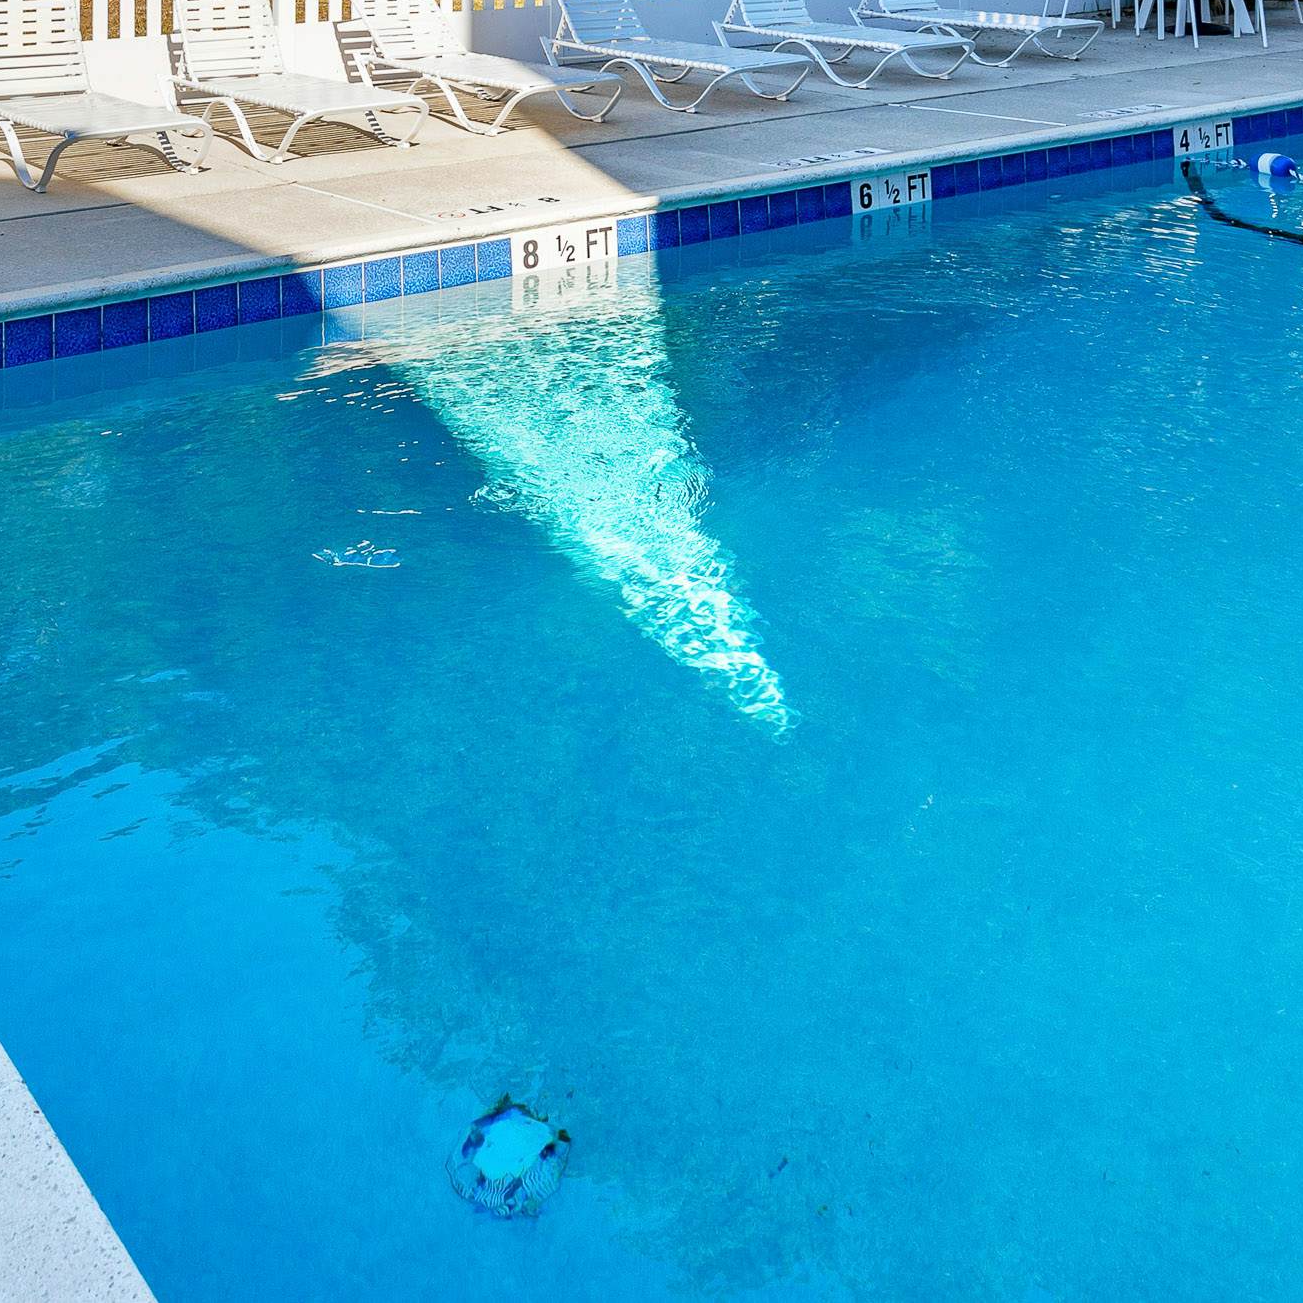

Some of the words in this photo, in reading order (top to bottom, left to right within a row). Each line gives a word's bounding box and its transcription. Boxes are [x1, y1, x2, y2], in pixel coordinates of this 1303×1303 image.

[1180, 129, 1190, 152] 4
[1215, 122, 1231, 147] FT
[859, 182, 873, 209] 6
[907, 172, 928, 202] FT
[522, 239, 539, 269] 8
[586, 226, 613, 259] FT
